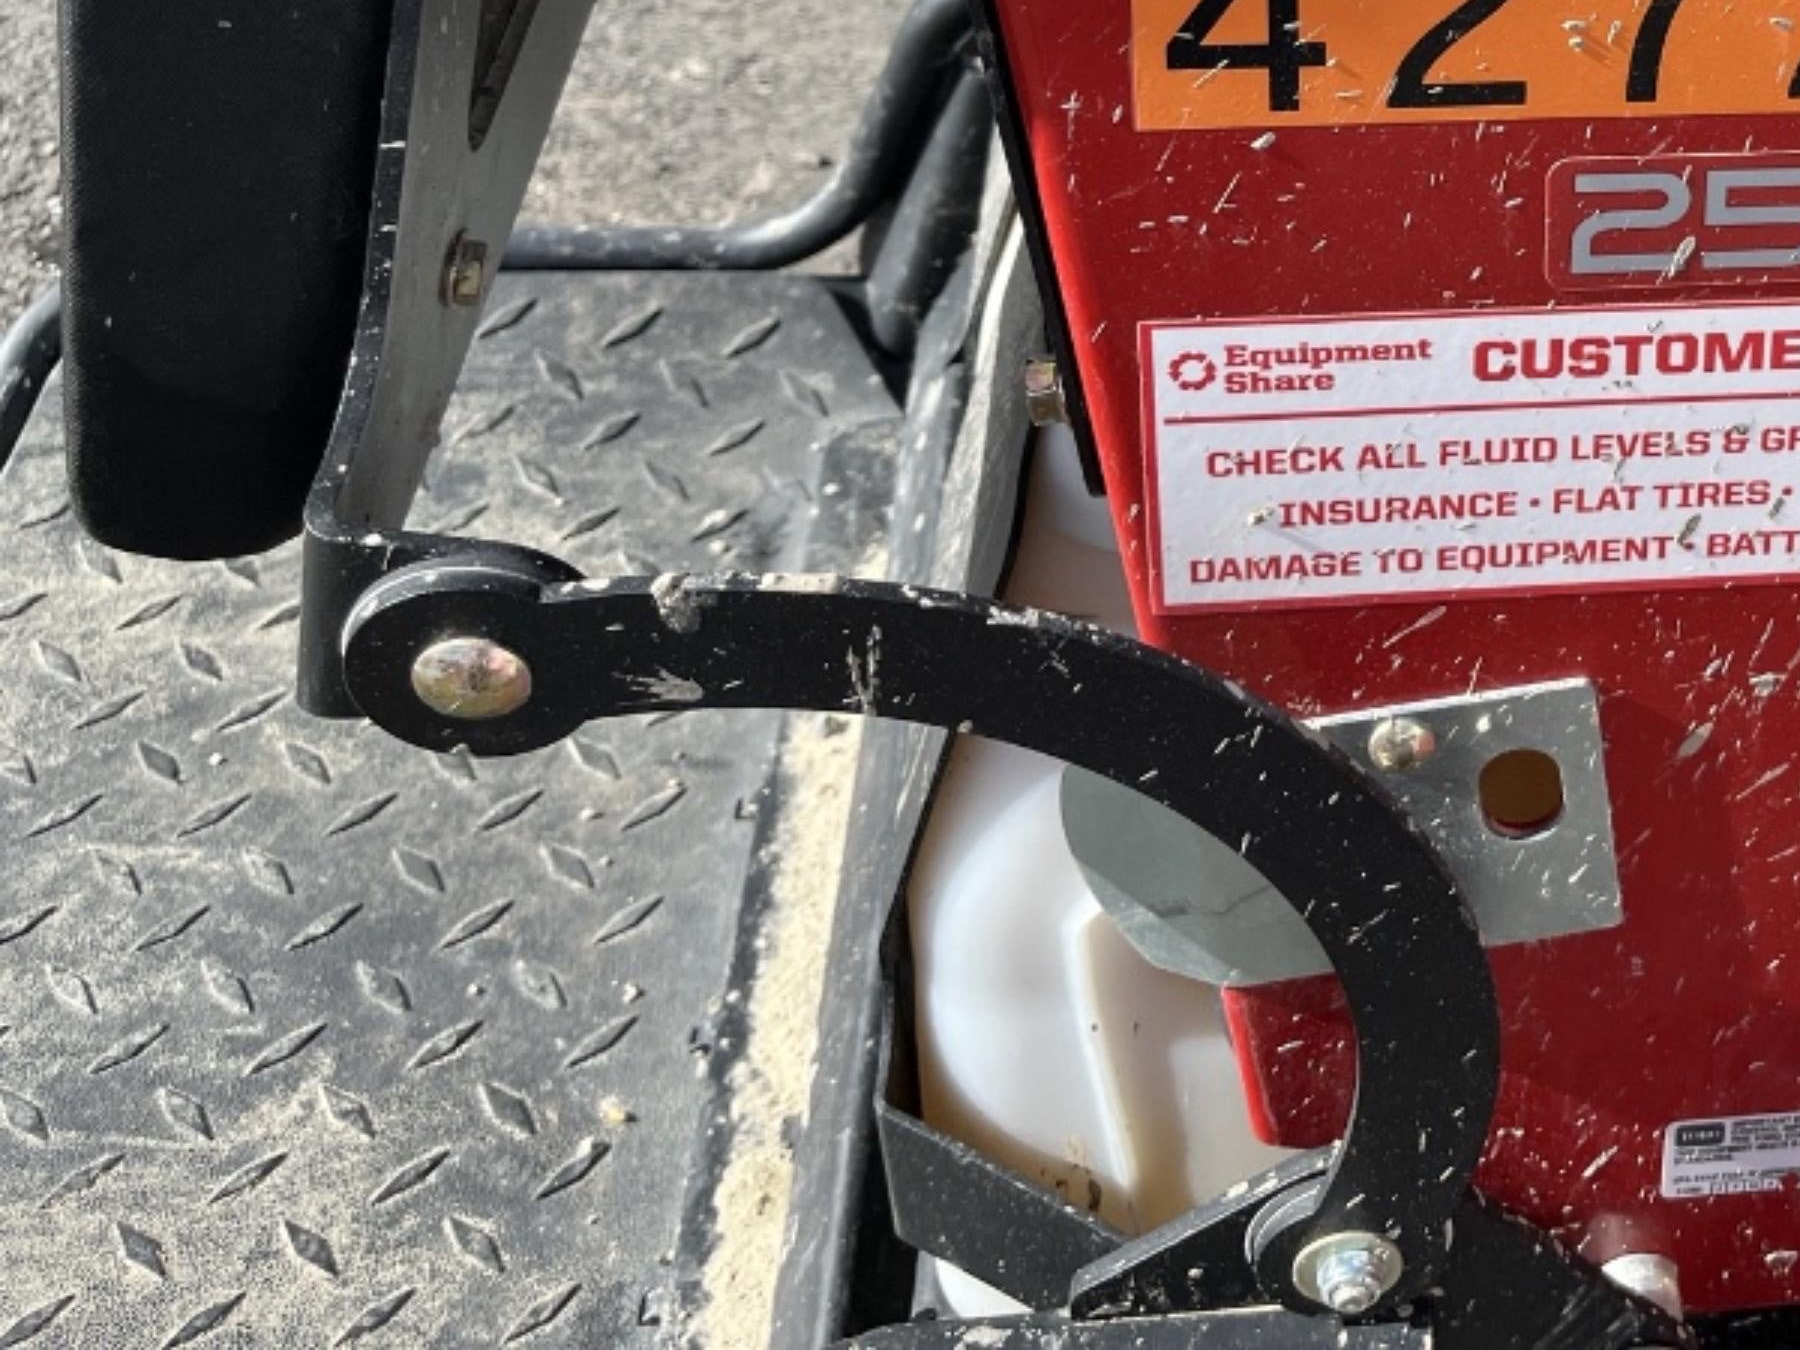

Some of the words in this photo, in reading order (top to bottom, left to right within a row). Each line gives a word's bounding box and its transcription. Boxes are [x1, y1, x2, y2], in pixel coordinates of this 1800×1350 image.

[1224, 338, 1432, 371] Equipment
[1224, 369, 1335, 395] Share
[1206, 446, 1344, 478] CHECK
[1356, 442, 1426, 470] ALL
[1438, 436, 1558, 467] FLUID
[1569, 430, 1711, 462] LEVELS
[1722, 426, 1749, 453] &
[1279, 490, 1518, 528] INSURANCE
[1552, 485, 1642, 514] FLAT
[1653, 480, 1771, 509] TIRES
[1190, 552, 1362, 584] DAMAGE
[1378, 547, 1424, 574] TO
[1436, 535, 1674, 573] EQUIPMENT
